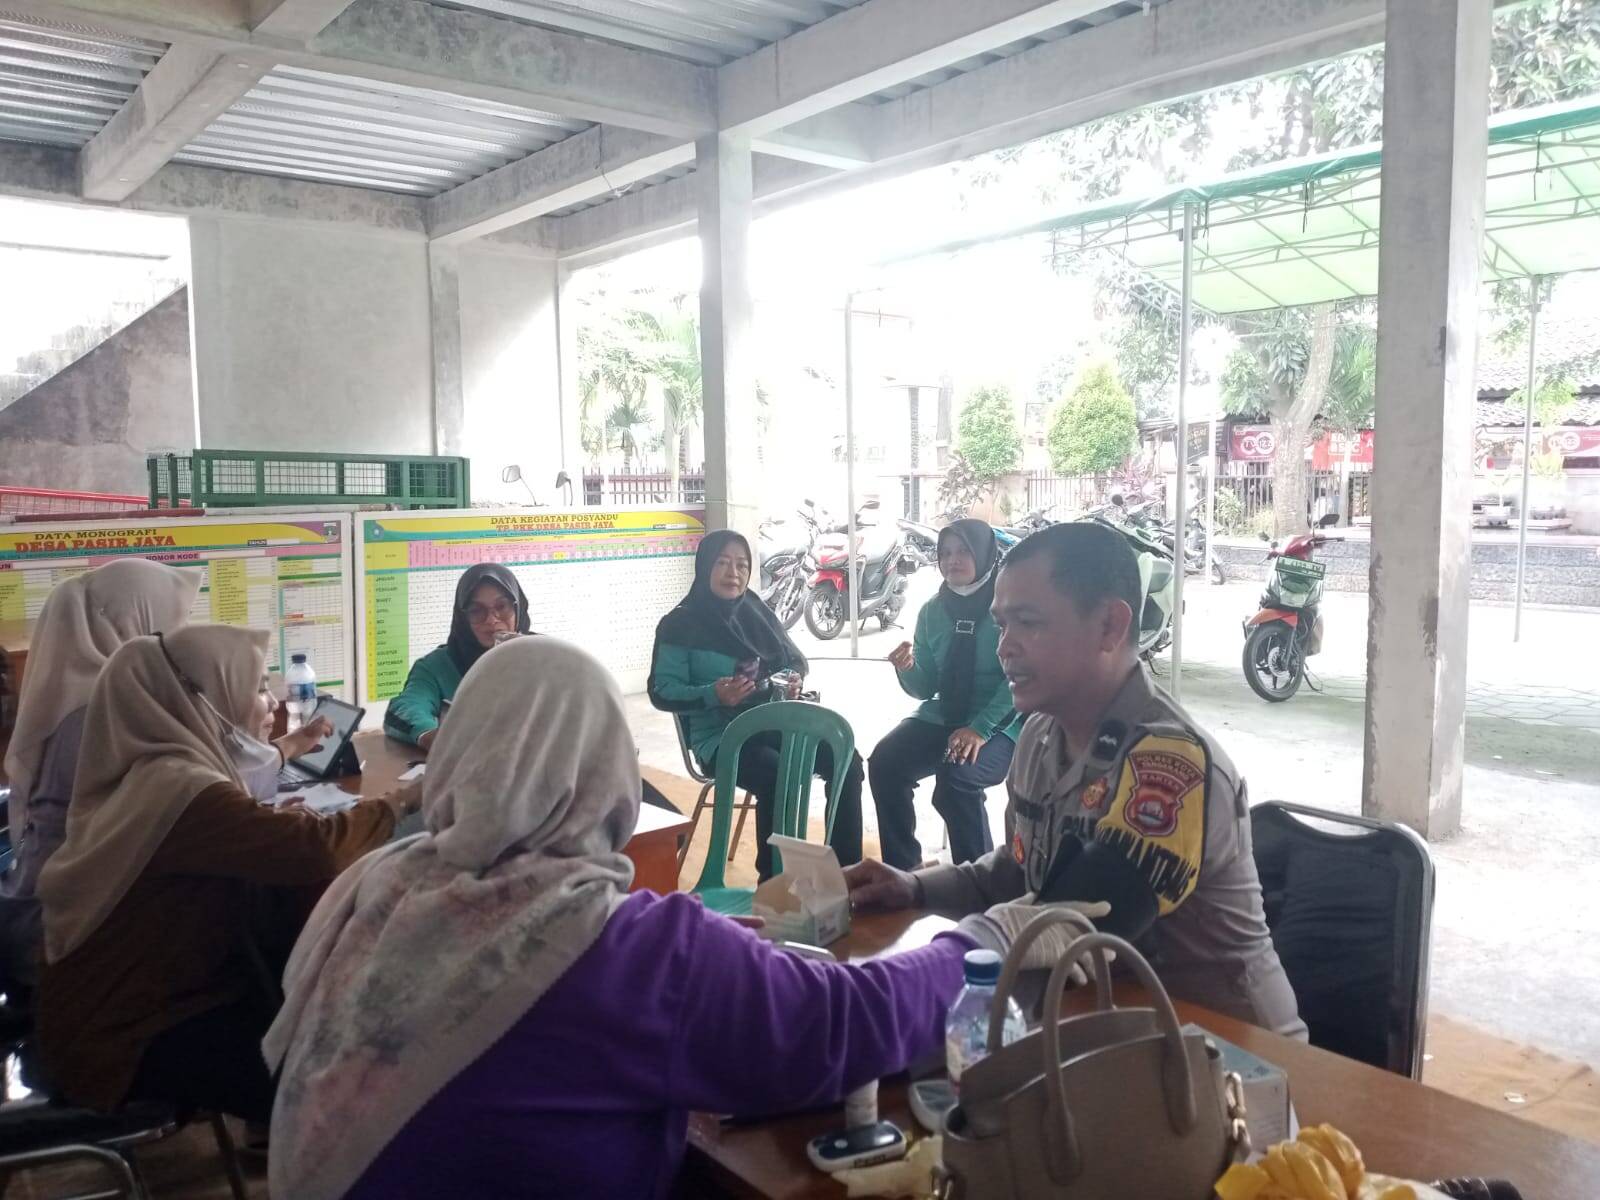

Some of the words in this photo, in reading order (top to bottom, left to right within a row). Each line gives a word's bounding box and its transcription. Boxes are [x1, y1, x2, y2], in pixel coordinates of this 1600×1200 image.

[491, 517, 517, 525] DATA
[520, 515, 568, 524] KEGIATAN
[571, 514, 619, 522] POSYANDU
[35, 532, 72, 540] DATA
[76, 529, 157, 539] MONOGRAFI
[15, 540, 67, 553] DESA
[72, 538, 129, 550] PASIR
[133, 536, 176, 547] JAYA
